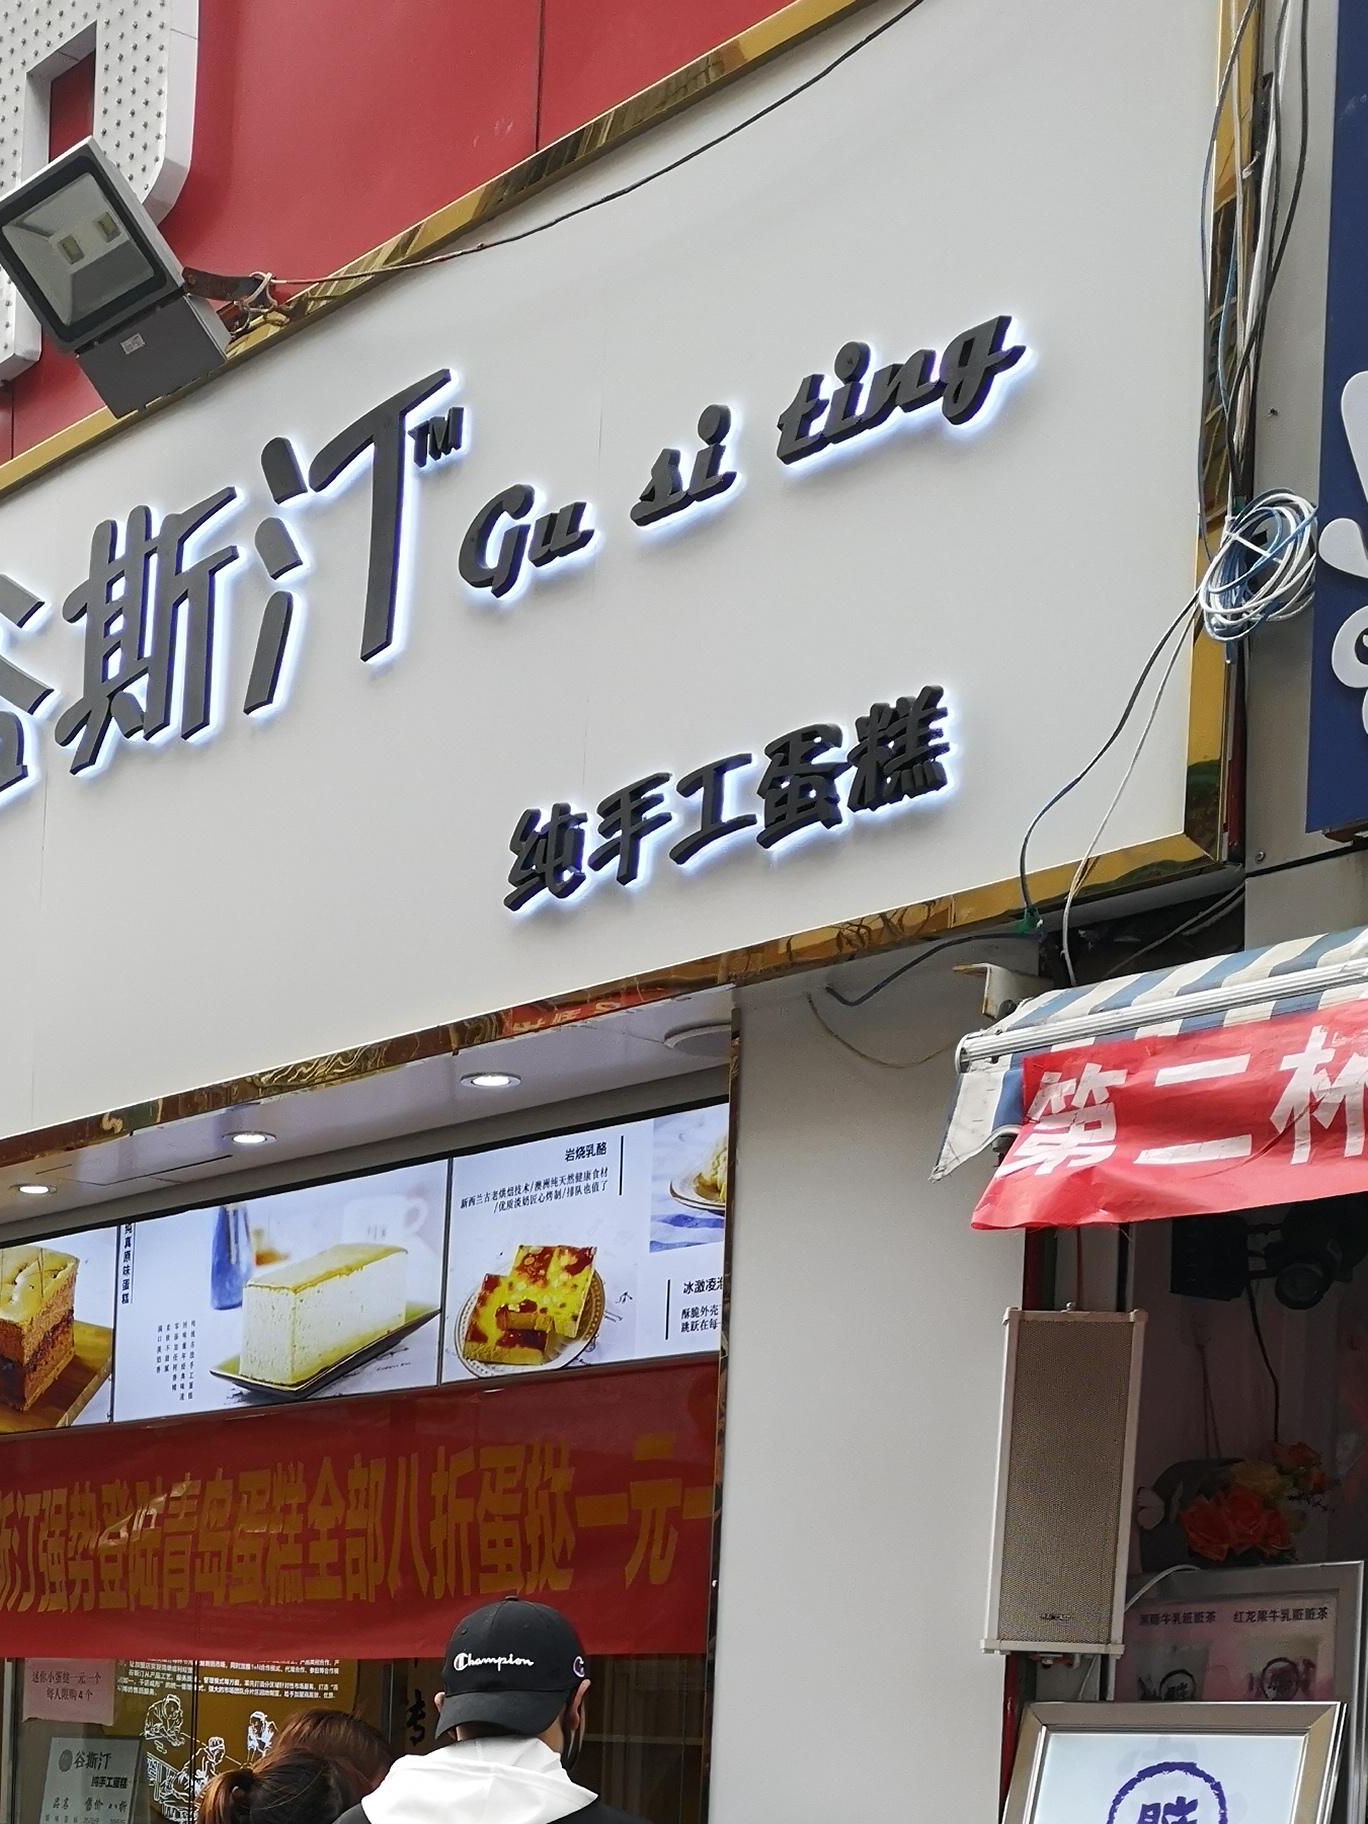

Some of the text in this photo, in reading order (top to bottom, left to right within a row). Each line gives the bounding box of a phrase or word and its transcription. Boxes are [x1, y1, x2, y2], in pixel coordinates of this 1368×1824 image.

[407, 405, 464, 466] TM
[458, 315, 1025, 597] Gu si ting
[503, 684, 951, 913] 纯手工蛋糕
[564, 1142, 608, 1162] 岩烧乳酪
[681, 1304, 721, 1320] 酥脆外壳
[453, 1652, 534, 1672] Champion
[74, 1751, 112, 1770] 谷斯汀
